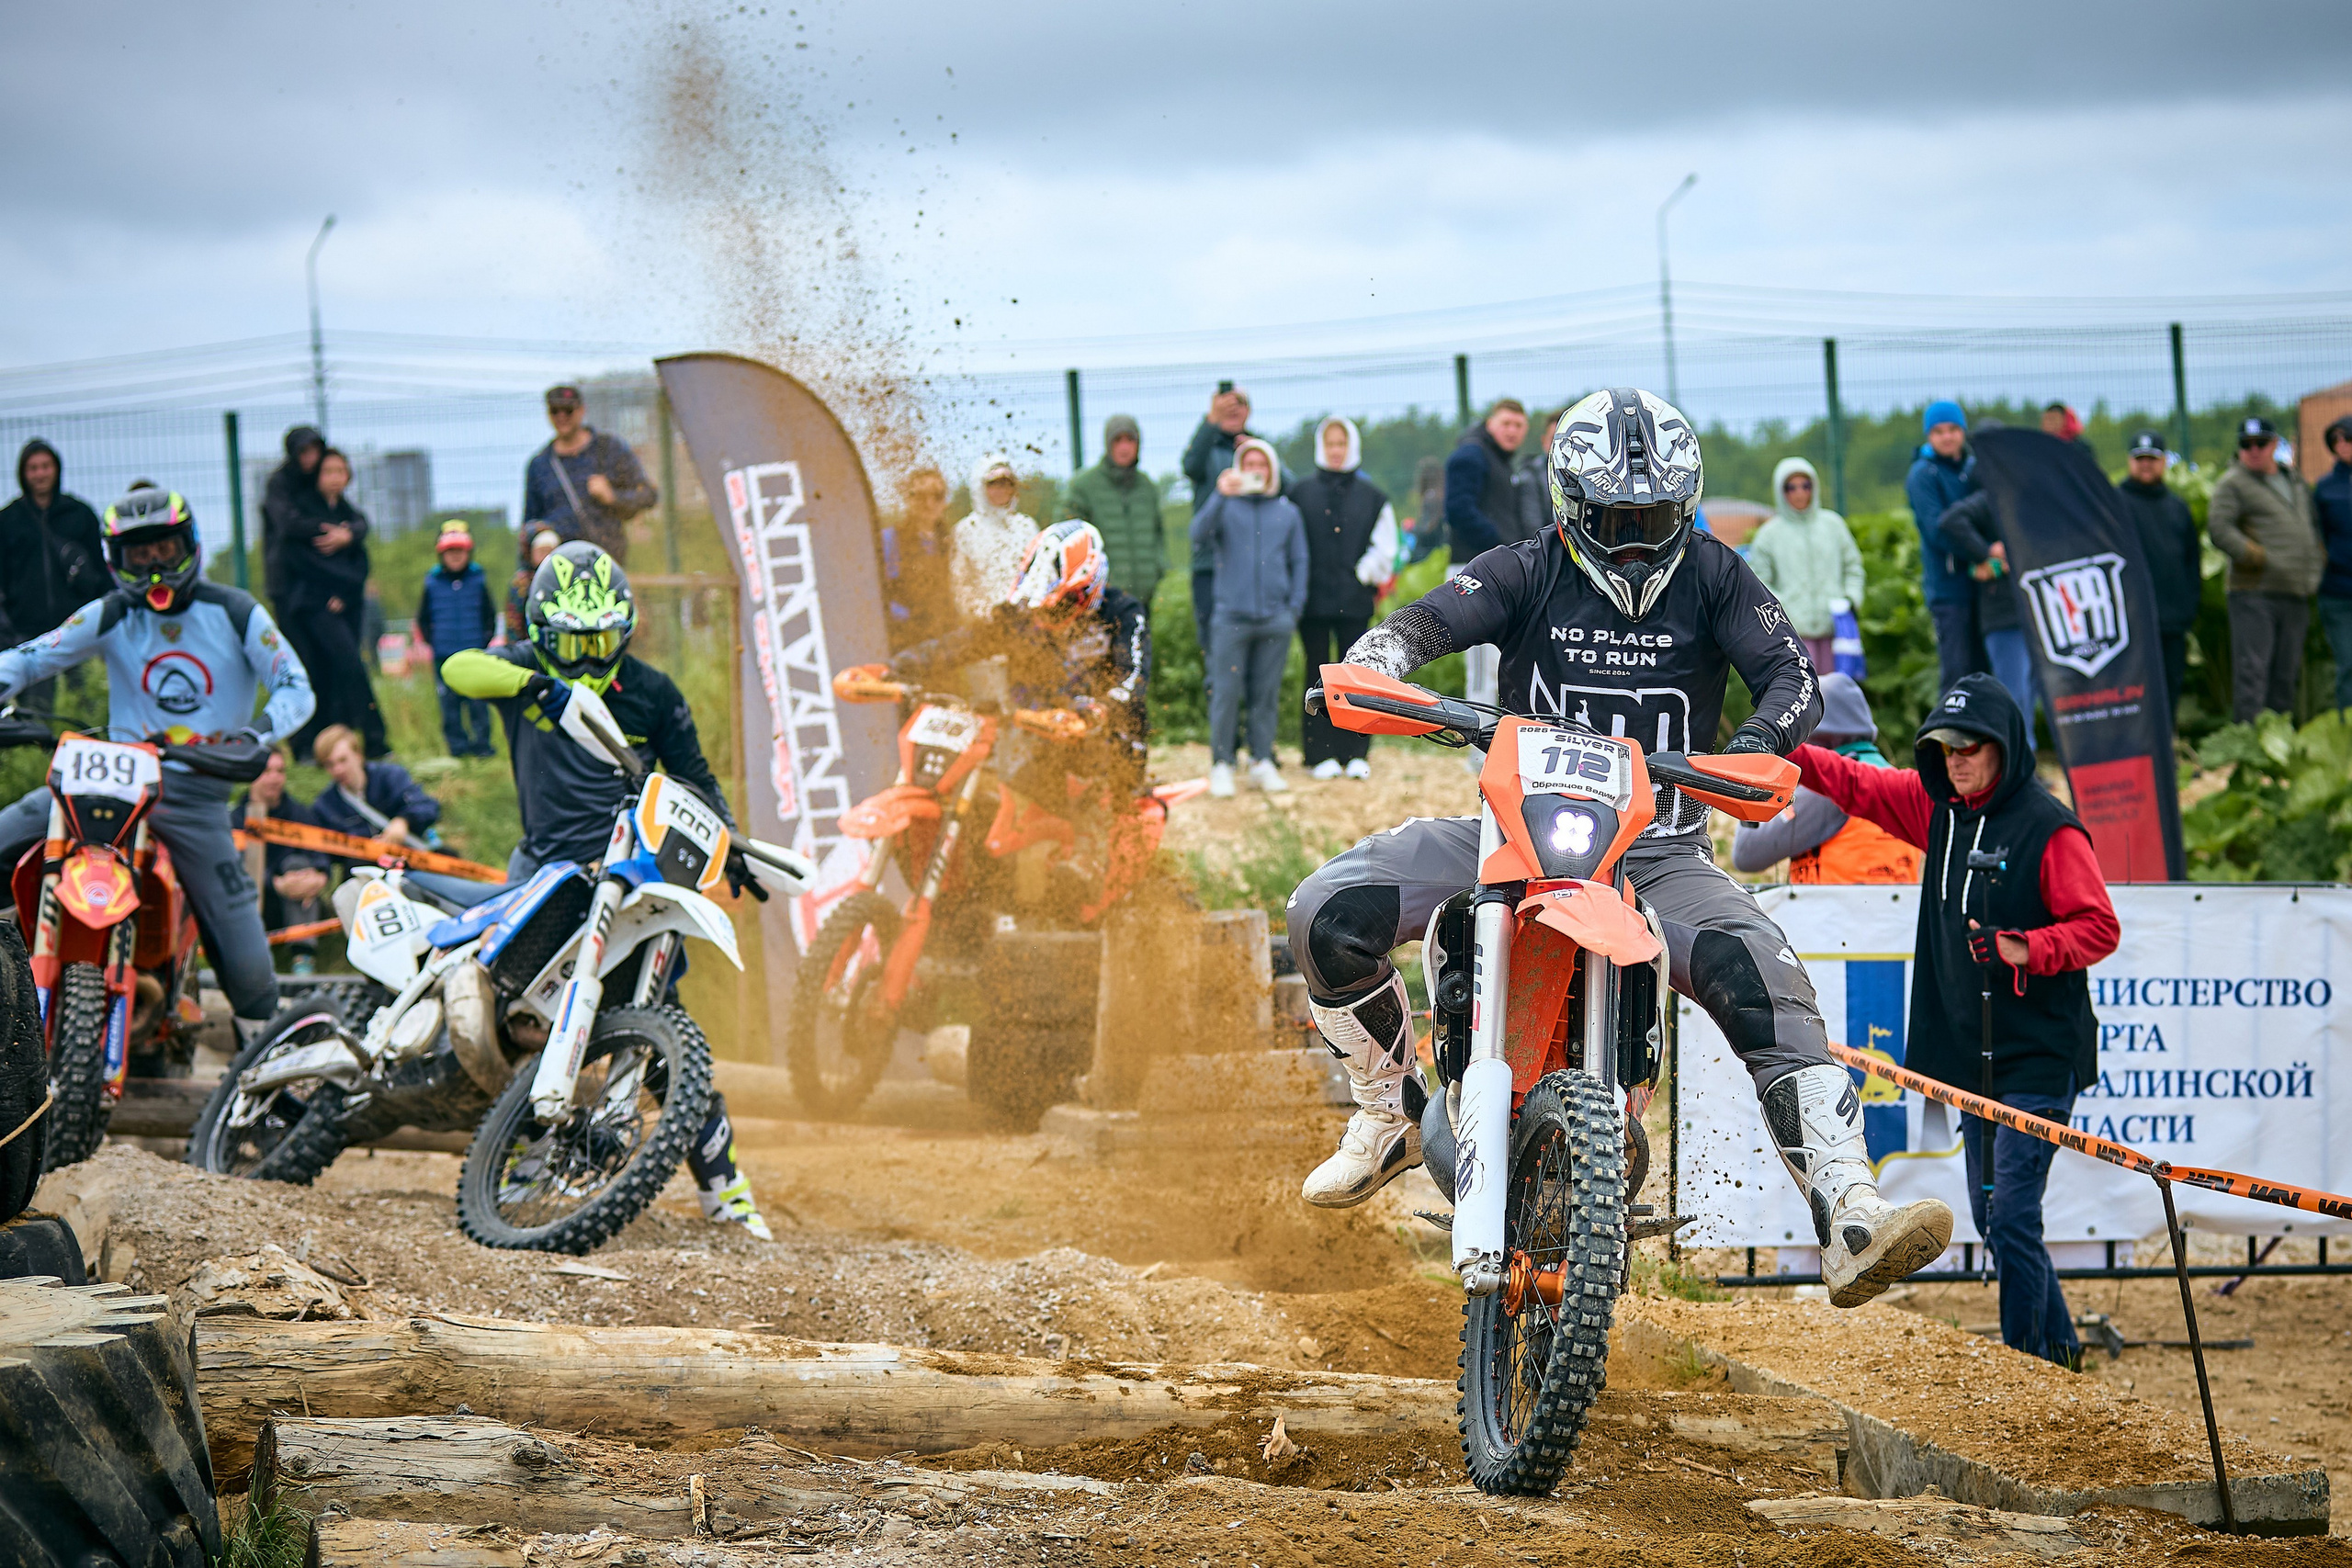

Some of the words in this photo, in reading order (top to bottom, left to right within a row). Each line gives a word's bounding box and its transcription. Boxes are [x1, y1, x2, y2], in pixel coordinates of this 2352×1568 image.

[1550, 626, 1585, 642] NO
[1564, 648, 1598, 664] TO
[1605, 650, 1657, 668] RUN
[1589, 668, 1611, 676] SINCE
[73, 750, 137, 785] 189
[1541, 746, 1611, 783] 112
[1532, 781, 1583, 791] Образцов
[1585, 785, 1616, 802] Вадим
[668, 799, 711, 841] 100
[2088, 977, 2333, 1007] НИСТЕРСТВО
[2099, 1022, 2167, 1052] РТА
[2078, 1061, 2315, 1098] АЛИНСКОЙ
